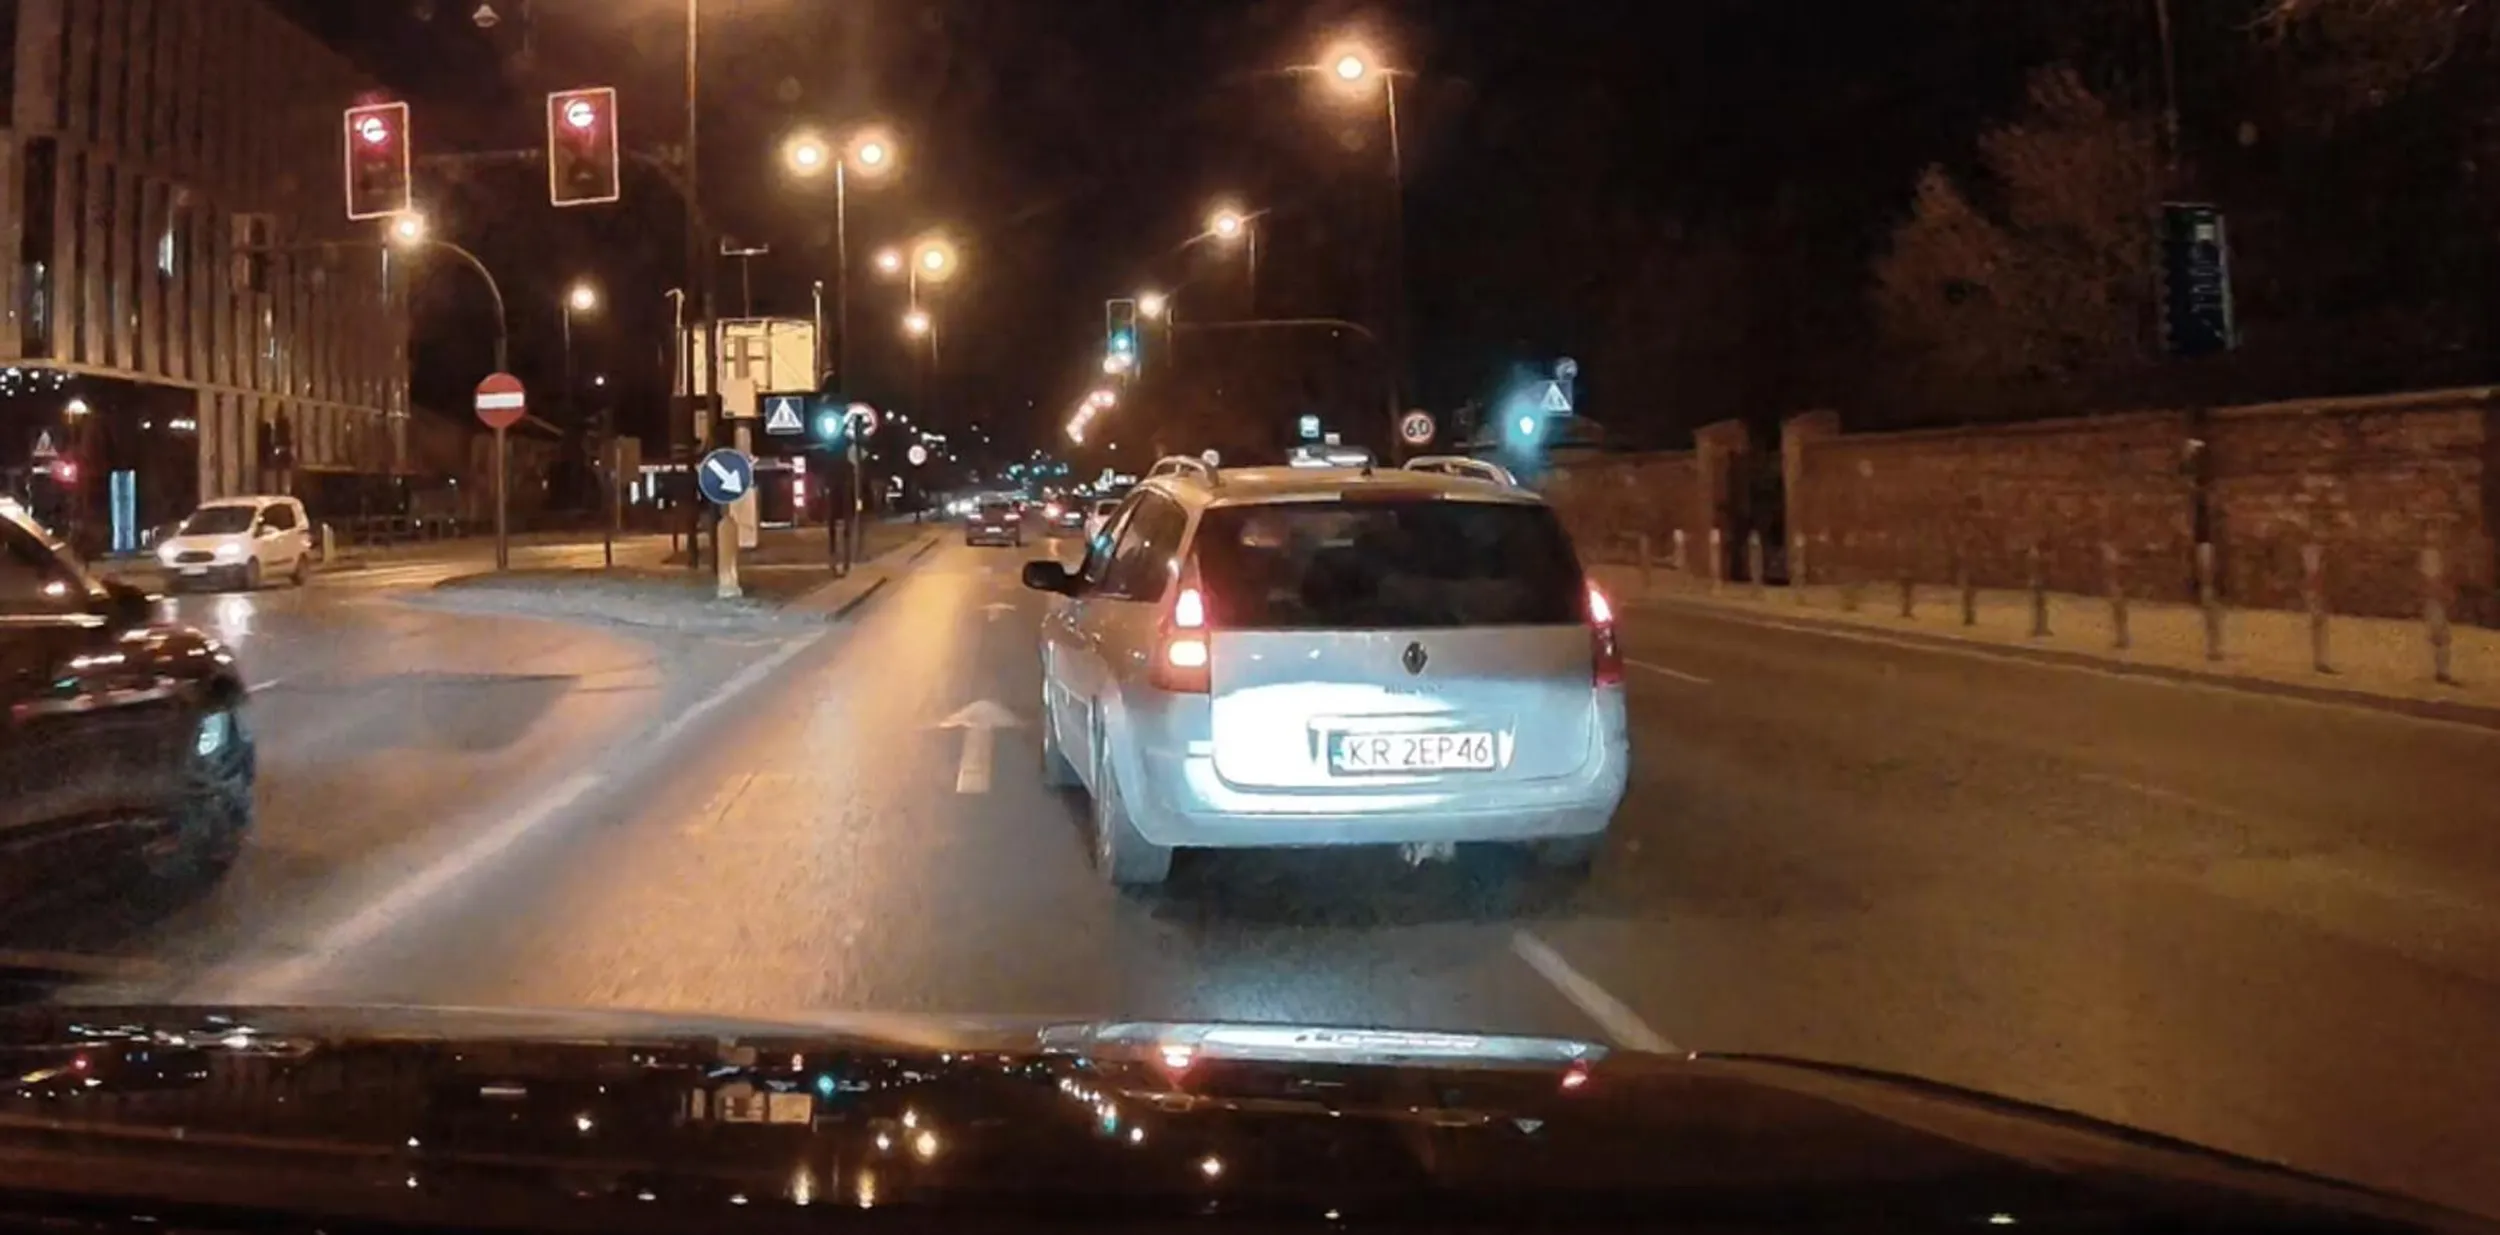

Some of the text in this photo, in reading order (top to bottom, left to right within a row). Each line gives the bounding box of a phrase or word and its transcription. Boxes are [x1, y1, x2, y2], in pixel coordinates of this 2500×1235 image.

[1406, 419, 1430, 438] 60
[1349, 736, 1489, 765] KR 2EP46
